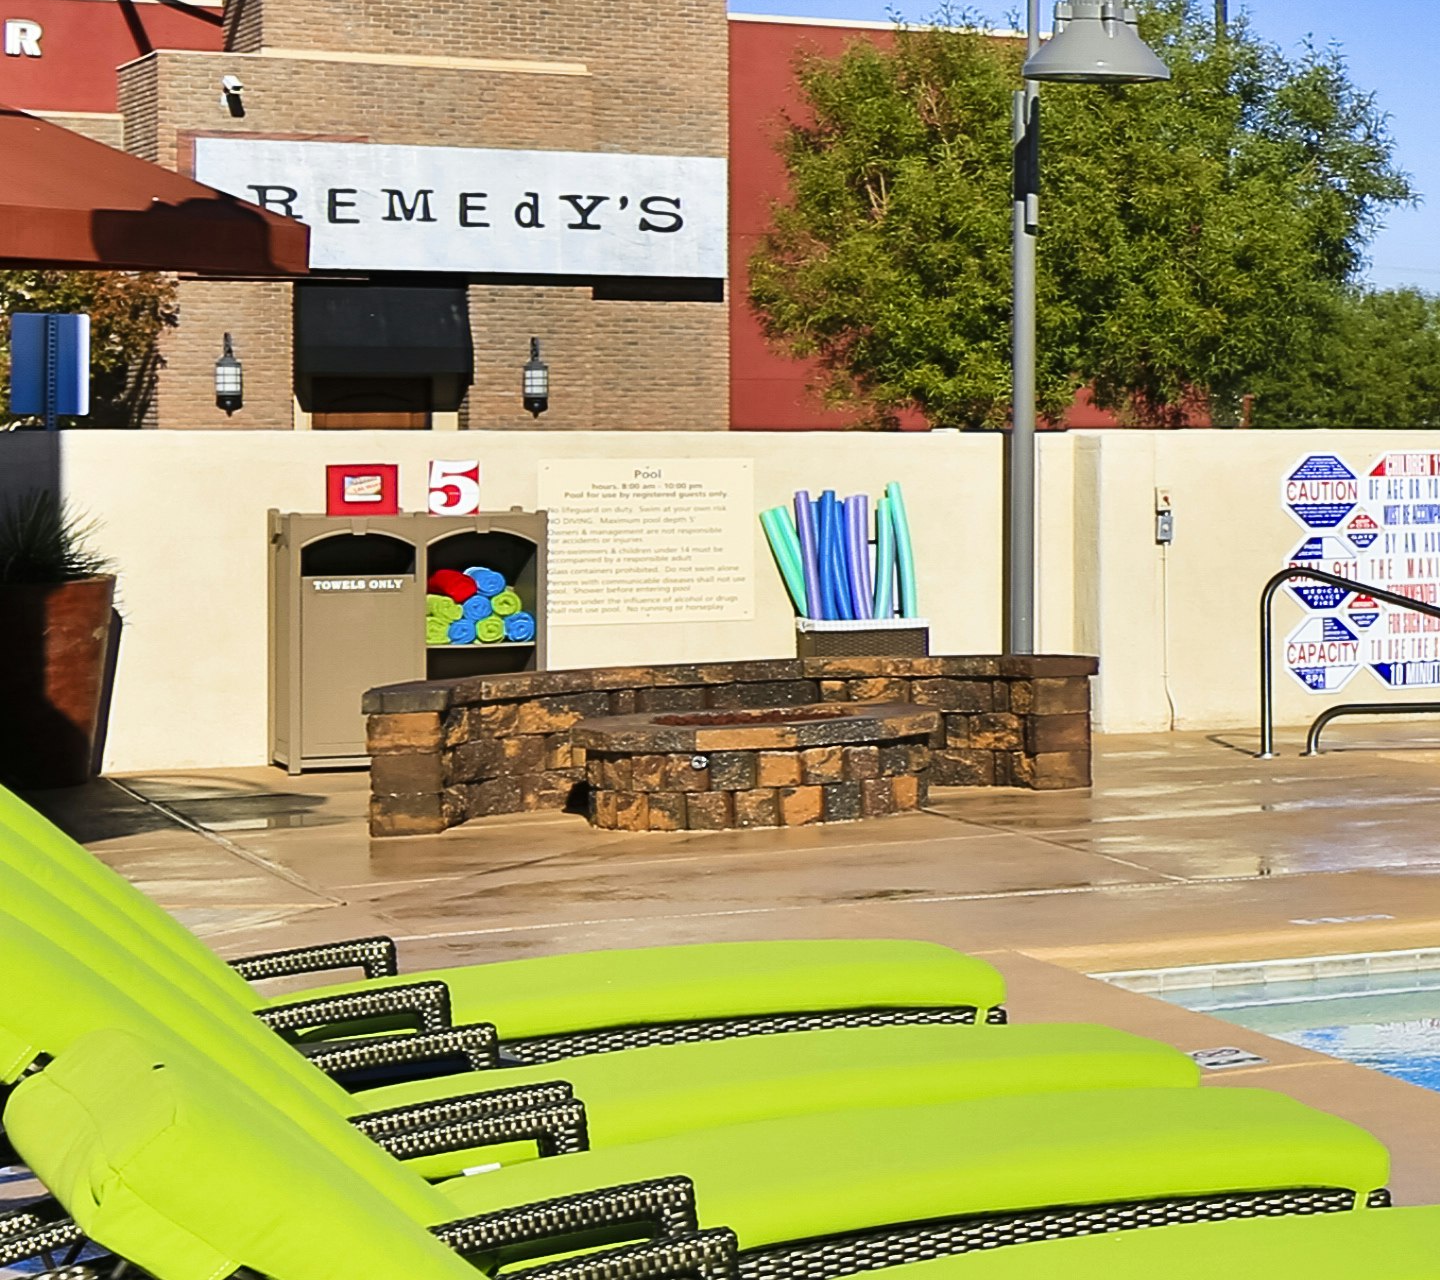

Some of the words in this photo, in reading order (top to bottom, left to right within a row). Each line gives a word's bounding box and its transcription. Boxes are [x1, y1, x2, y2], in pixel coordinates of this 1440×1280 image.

[4, 18, 42, 58] R
[634, 469, 662, 479] Pool
[1385, 454, 1429, 476] CHILDREN
[428, 459, 480, 516] 5
[564, 491, 584, 499] Pool
[586, 491, 599, 499] for
[619, 491, 630, 499] by
[632, 491, 676, 499] registered
[708, 491, 728, 499] only
[688, 483, 703, 491] pm
[1286, 481, 1358, 501] CAUTION
[1369, 479, 1379, 500] OF
[1387, 479, 1404, 499] AGE
[1409, 478, 1420, 499] OR
[561, 506, 599, 515] lifeguard
[600, 516, 640, 524] Maximum
[1383, 504, 1401, 525] MUST
[1402, 504, 1410, 525] BE
[1385, 533, 1396, 554] BY
[1404, 532, 1416, 553] AN
[1333, 561, 1357, 581] 911
[1370, 559, 1392, 579] THE
[313, 580, 366, 590] TOWELS
[369, 579, 403, 589] ONLY
[1388, 613, 1401, 634] FOR
[1403, 613, 1420, 633] SUCH
[1286, 642, 1359, 664] CAPACITY
[1370, 639, 1382, 660] TO
[1388, 638, 1405, 659] USE
[1411, 637, 1428, 658] THE
[1305, 674, 1324, 684] SPA
[1389, 663, 1404, 685] 10
